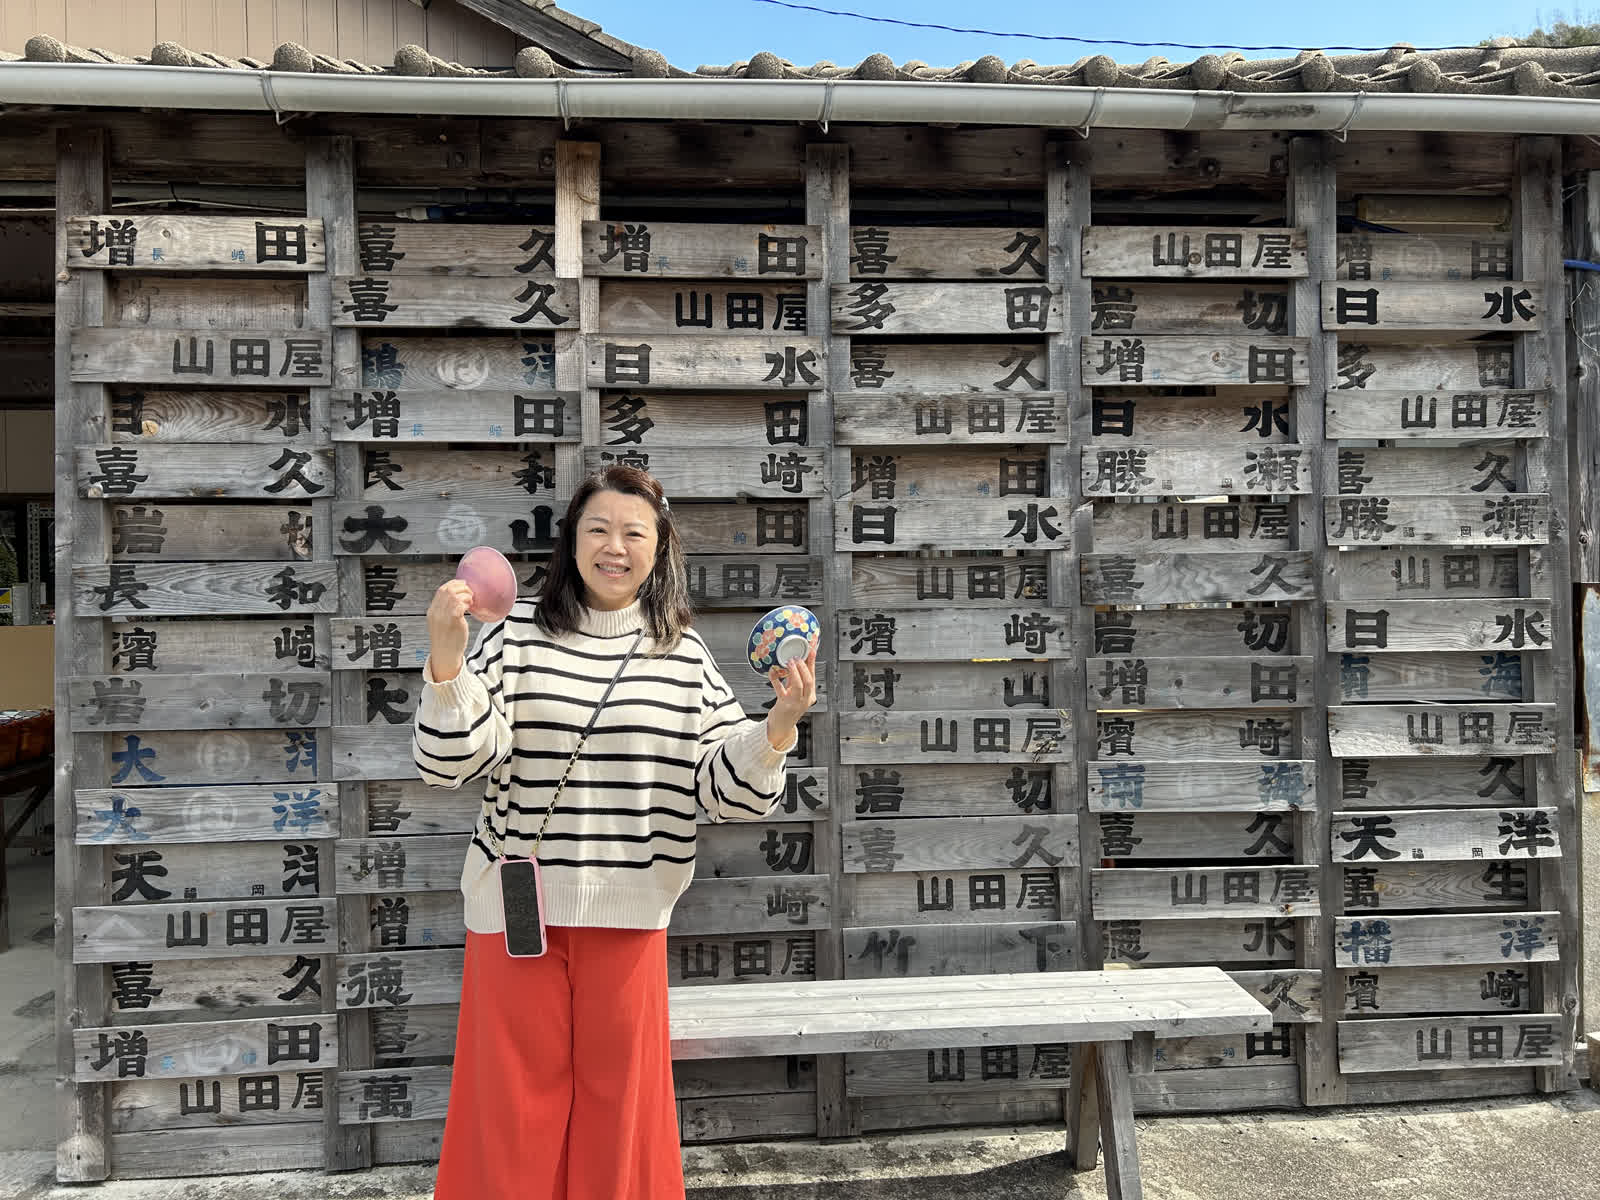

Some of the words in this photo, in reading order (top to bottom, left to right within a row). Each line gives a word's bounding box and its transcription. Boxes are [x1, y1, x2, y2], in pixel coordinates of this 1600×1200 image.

[81, 219, 137, 266] 増
[255, 221, 306, 264] 田
[360, 224, 405, 272] 喜
[514, 228, 555, 274] 久
[599, 224, 650, 272] 増
[758, 233, 808, 276] 田
[850, 227, 898, 274] 喜
[999, 231, 1046, 276] 久
[1153, 232, 1292, 269] 山田屋
[1472, 240, 1513, 280] 田
[342, 277, 399, 322] 喜
[510, 280, 569, 325] 久
[675, 290, 807, 331] 山田屋
[847, 283, 896, 330] 多
[1004, 286, 1052, 331] 田
[1236, 288, 1288, 332] 切
[1337, 287, 1379, 325] 日
[1481, 286, 1536, 323] 水
[172, 336, 324, 378] 山田屋
[605, 343, 652, 384] 日
[761, 346, 821, 388] 水
[850, 347, 895, 388] 喜
[993, 347, 1046, 391] 久
[1096, 338, 1145, 383] 増
[1249, 346, 1296, 384] 田
[1337, 344, 1376, 389] 多
[111, 390, 145, 436] 日
[262, 393, 311, 437] 水
[344, 390, 401, 438] 増
[514, 394, 566, 437] 田
[604, 395, 654, 446] 多
[763, 399, 807, 446] 田
[915, 398, 1056, 435] 山田屋
[1092, 400, 1136, 437] 日
[1239, 400, 1288, 438] 水
[1401, 394, 1537, 429] 山田屋
[89, 446, 148, 494] 喜
[263, 447, 325, 494] 久
[364, 451, 404, 490] 長
[512, 452, 555, 494] 和
[760, 452, 814, 493] 崎
[850, 456, 898, 500] 増
[1000, 458, 1046, 498] 田
[1088, 449, 1155, 494] 勝
[1338, 451, 1373, 494] 喜
[1470, 451, 1516, 493] 久
[112, 506, 167, 554] 岩
[338, 505, 413, 553] 大
[508, 505, 567, 551] 山
[757, 507, 809, 546] 田
[852, 505, 898, 544] 日
[1003, 503, 1063, 542] 水
[1152, 505, 1289, 540] 山田屋
[1332, 497, 1397, 541] 勝
[94, 565, 150, 611] 長
[264, 566, 327, 610] 和
[365, 564, 406, 611] 喜
[917, 565, 1048, 600] 山田屋
[1100, 556, 1145, 600] 喜
[1246, 554, 1302, 596] 久
[1395, 554, 1519, 590] 山田屋
[347, 623, 402, 668] 増
[1003, 612, 1057, 654] 崎
[1237, 610, 1291, 652] 切
[1345, 608, 1390, 649] 日
[1492, 608, 1549, 648] 水
[88, 677, 146, 725] 岩
[262, 678, 325, 725] 切
[367, 677, 413, 725] 大
[1002, 671, 1050, 707] 山
[1098, 658, 1148, 705] 増
[1251, 662, 1298, 703] 田
[920, 717, 1066, 753] 山田屋
[1239, 718, 1290, 756] 崎
[1406, 711, 1543, 745] 山田屋
[112, 735, 166, 783] 大
[1477, 757, 1524, 798] 久
[781, 773, 823, 814] 水
[855, 768, 905, 814] 岩
[1005, 767, 1051, 810] 切
[1097, 763, 1146, 809] 南
[89, 796, 152, 841] 大
[272, 789, 326, 832] 洋
[1100, 813, 1143, 857] 喜
[1244, 812, 1292, 856] 久
[1340, 815, 1401, 860] 天
[1498, 811, 1555, 857] 洋
[351, 842, 407, 889] 増
[759, 829, 814, 873] 切
[855, 827, 905, 873] 喜
[1009, 823, 1065, 868] 久
[111, 850, 172, 901] 天
[917, 872, 1061, 912] 山田屋
[1170, 870, 1311, 906] 山田屋
[166, 905, 330, 948] 山田屋
[767, 884, 821, 925] 崎
[681, 939, 815, 979] 山田屋
[1243, 919, 1295, 957] 水
[1500, 917, 1545, 961] 洋
[111, 961, 163, 1009] 喜
[277, 955, 321, 1001] 久
[90, 1030, 149, 1078] 増
[267, 1022, 322, 1065] 田
[373, 1007, 418, 1055] 喜
[1246, 1023, 1291, 1060] 田
[1416, 1024, 1553, 1061] 山田屋
[927, 1043, 1071, 1082] 山田屋
[180, 1071, 323, 1115] 山田屋
[359, 1075, 413, 1120] 萬
